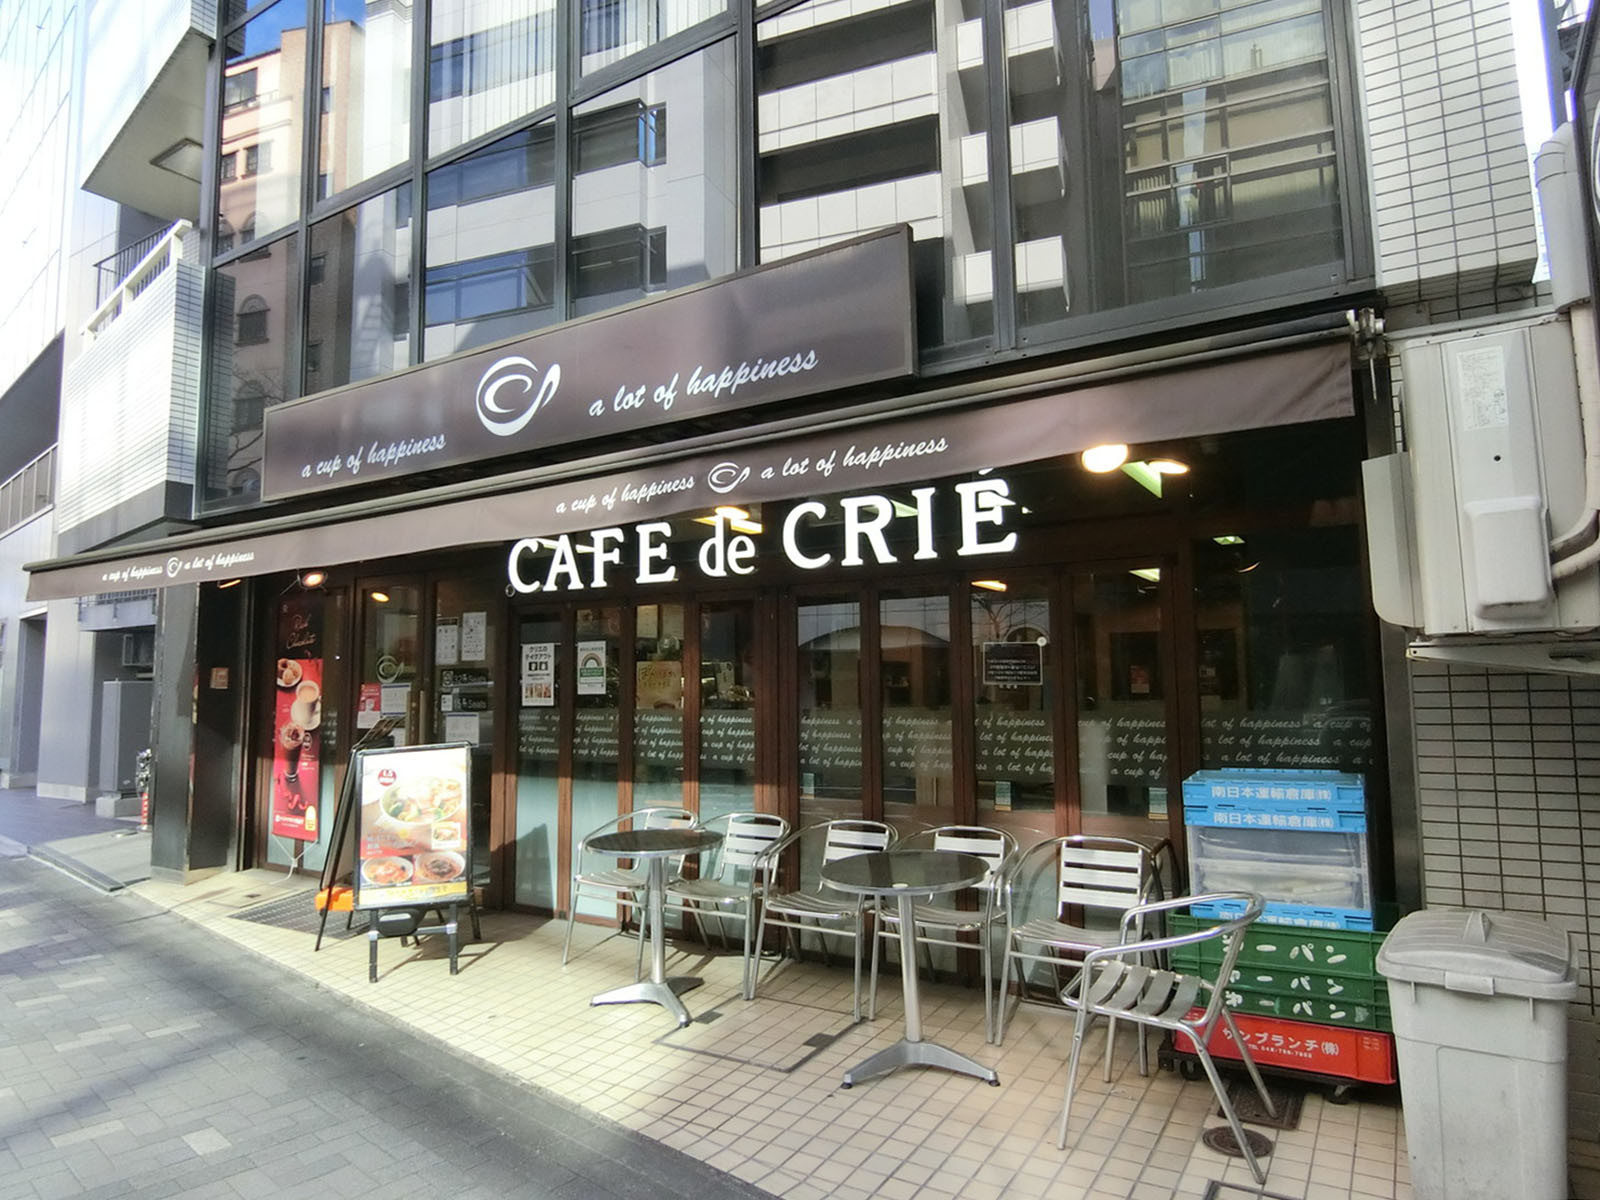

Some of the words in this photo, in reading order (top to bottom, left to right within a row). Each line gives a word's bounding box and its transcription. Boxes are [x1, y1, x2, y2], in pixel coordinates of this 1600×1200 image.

[589, 400, 604, 417] a
[613, 385, 647, 412] lot
[653, 373, 679, 410] of
[686, 349, 818, 398] happiness
[301, 465, 312, 477] a
[316, 455, 342, 477] cup
[346, 446, 364, 474] of
[367, 434, 446, 467] happiness
[760, 467, 774, 479] a
[782, 460, 809, 476] lot
[815, 450, 837, 476] of
[842, 437, 949, 468] happiness
[556, 504, 567, 514] a
[571, 494, 597, 514] cup
[601, 486, 617, 509] of
[620, 475, 695, 503] happiness
[507, 522, 677, 595] CAFE
[699, 508, 756, 577] de
[192, 556, 203, 569] lot
[205, 554, 215, 571] of
[215, 552, 255, 568] happiness
[109, 572, 121, 583] cup
[122, 567, 130, 582] of
[130, 565, 164, 580] happiness
[707, 715, 715, 725] of
[718, 714, 752, 725] happiness
[801, 716, 839, 726] happiness
[896, 716, 938, 728] happiness
[983, 716, 992, 729] of
[996, 716, 1045, 728] happiness
[1101, 718, 1112, 730] of
[1222, 718, 1234, 730] of
[1240, 717, 1301, 730] happiness
[702, 728, 714, 736] cup
[717, 727, 724, 738] of
[801, 730, 809, 740] of
[812, 729, 851, 740] happiness
[895, 731, 904, 742] of
[979, 731, 993, 741] lot
[997, 731, 1007, 744] of
[711, 742, 723, 750] cup
[726, 740, 734, 751] of
[1117, 733, 1128, 746] of
[1218, 735, 1235, 745] lot
[1240, 735, 1252, 748] of
[1258, 734, 1320, 748] happiness
[812, 743, 820, 753] of
[888, 746, 903, 756] cup
[907, 745, 916, 756] of
[993, 746, 1007, 757] lot
[1010, 747, 1021, 759] of
[658, 750, 666, 761] of
[720, 754, 733, 762] cup
[737, 754, 745, 764] of
[809, 756, 820, 765] lot
[823, 756, 831, 767] of
[1107, 751, 1127, 762] cup
[1132, 750, 1144, 763] of
[1236, 752, 1252, 762] lot
[1258, 752, 1270, 765] of
[1276, 752, 1340, 766] happiness
[900, 760, 915, 770] cup
[1007, 762, 1021, 772] lot
[1025, 762, 1036, 775] of
[1124, 767, 1144, 779] cup
[1149, 767, 1161, 780] of
